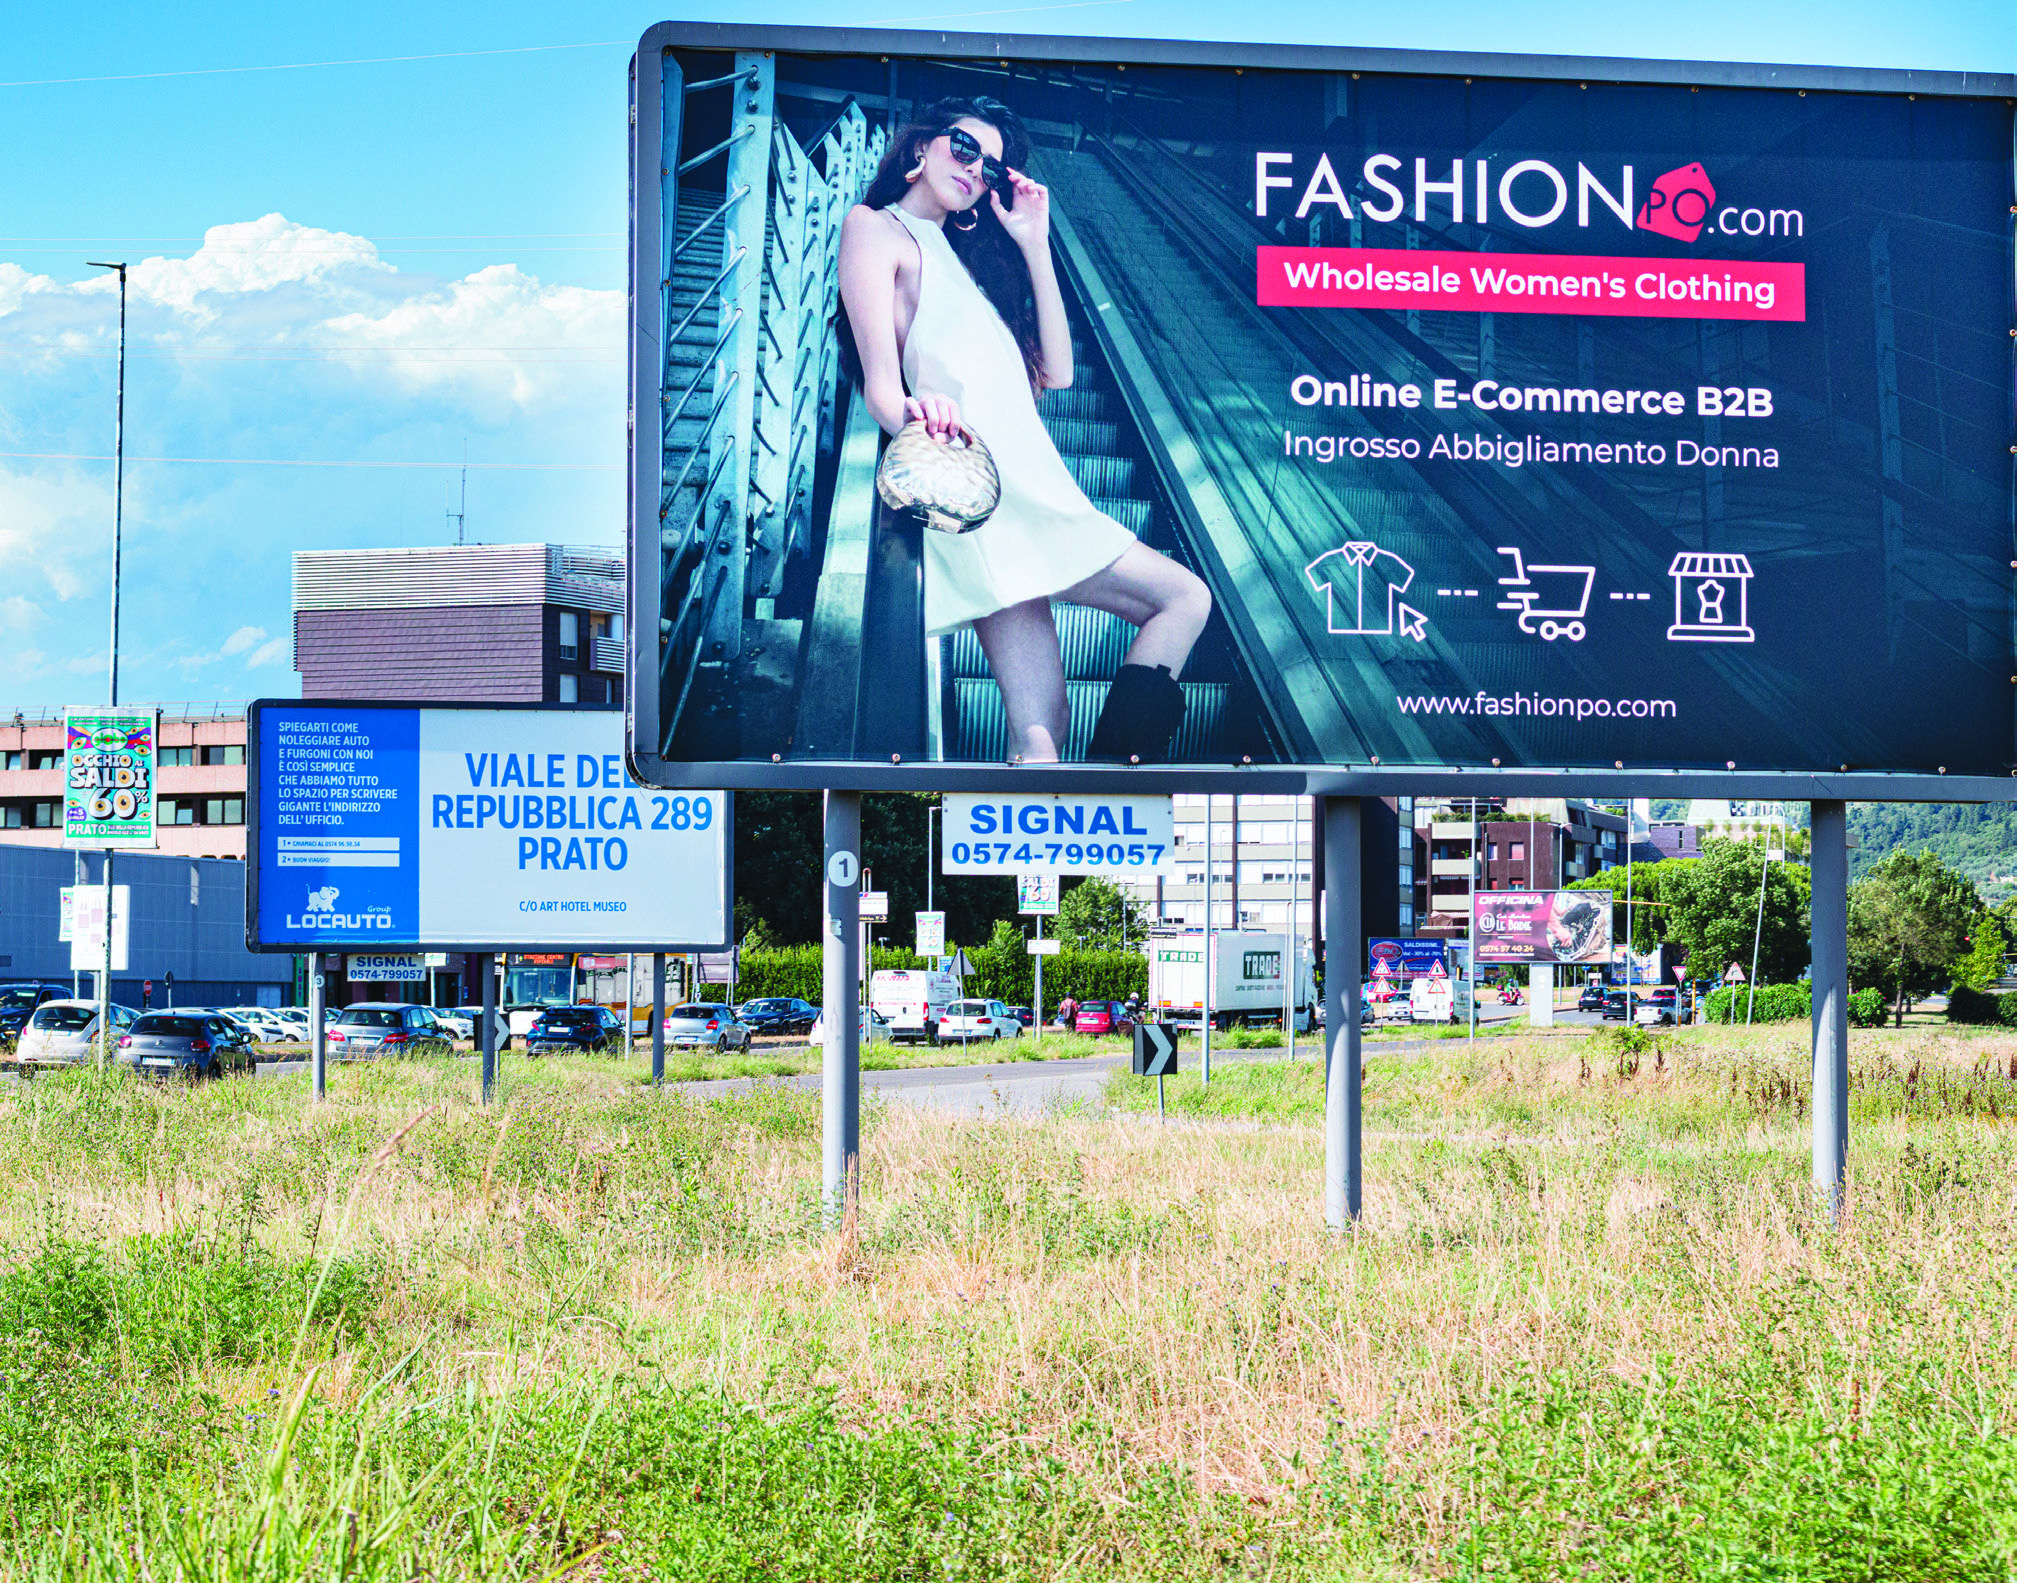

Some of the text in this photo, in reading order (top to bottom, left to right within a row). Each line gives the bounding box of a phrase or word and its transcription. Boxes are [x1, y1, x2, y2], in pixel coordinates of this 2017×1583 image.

[1284, 262, 1776, 309] Wholesale Women's Clothing
[1290, 374, 1774, 417] Online E-Commerce B2B
[1285, 431, 1780, 468] Ingrosso Abbigliamento Donna
[1397, 692, 1677, 721] www.fashionpo.com
[278, 722, 359, 733] SPIEGARTI COME
[94, 732, 127, 746] globo
[278, 735, 370, 746] NOLEGGIARE AUTO
[278, 748, 374, 760] E FURGONI CON NOI
[71, 754, 132, 768] OCCHIO
[286, 759, 308, 772] COSÌ
[310, 762, 356, 772] SEMPLICE
[465, 753, 566, 788] VIALE
[70, 767, 149, 789] SALDI
[278, 774, 379, 786] CHE ABBIAMO TUTTO
[278, 788, 398, 799] LO SPAZIO PER SCRIVERE
[278, 801, 322, 812] GIGANTE
[432, 794, 713, 831] REPUBBLICA 289
[305, 814, 345, 825] UFFICIO.
[969, 804, 1148, 835] SIGNAL
[68, 823, 107, 835] PRATO
[518, 836, 629, 871] PRATO
[951, 842, 1166, 866] 0574-799057
[838, 858, 849, 878] 1
[1478, 895, 1544, 905] OFFICINA
[367, 905, 392, 914] Group
[519, 901, 627, 913] C/O ART HOTEL MUSEO
[286, 914, 392, 929] LOCAUTO
[1479, 944, 1535, 953] 0574 57 40 24
[356, 956, 417, 968] SIGNAL
[1160, 951, 1204, 962] TRADE
[1244, 955, 1280, 977] TRADE
[350, 969, 423, 980] 0574-799057
[316, 977, 324, 987] 3
